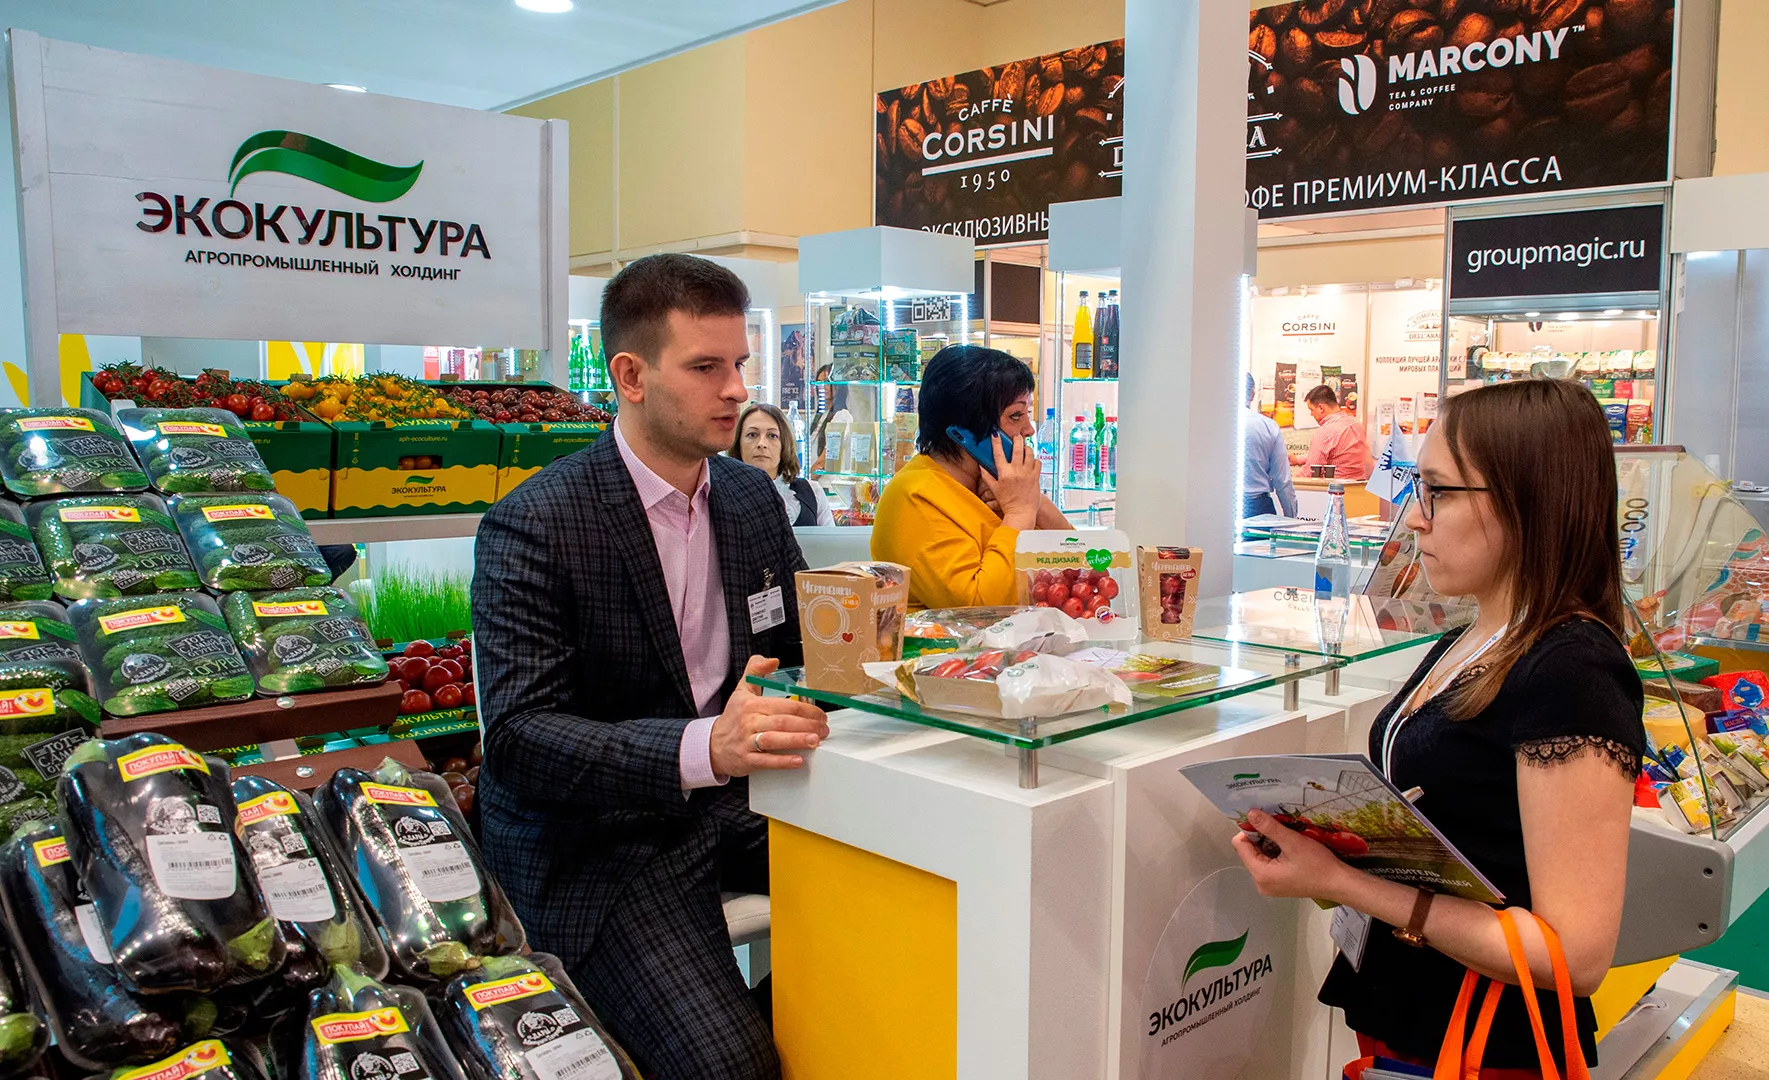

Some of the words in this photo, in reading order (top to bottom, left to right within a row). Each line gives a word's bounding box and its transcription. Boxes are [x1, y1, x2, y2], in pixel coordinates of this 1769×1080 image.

[1388, 27, 1570, 84] MARCONY
[1389, 91, 1407, 100] TEA
[1410, 89, 1416, 97] &
[1420, 83, 1457, 96] COFFEE
[958, 94, 1013, 122] CAFFÈ
[1388, 98, 1434, 111] COMPANY
[921, 115, 1054, 161] CORSINI
[960, 168, 1011, 193] 1950
[1292, 155, 1562, 208] ПРЕМИУМ-КЛАССА
[135, 191, 492, 260] ЭКОКУЛЬТУРА
[185, 249, 380, 276] АГРОПРОМЫШЛЕННЫЙ
[390, 262, 462, 281] ХОЛДИНГ
[1467, 236, 1646, 273] groupmagic.ru
[1282, 322, 1336, 332] CORSINI
[391, 486, 447, 494] ЭКОКУЛЬТУРА
[1036, 557, 1051, 565] РЕД
[129, 752, 181, 771] ПОКУПАЙ!
[1225, 778, 1282, 790] ЭКОКУЛЬТУРА
[476, 983, 519, 1000] ПОКУПАЙ!
[1148, 954, 1273, 1036] ЭКОКУЛЬТУРА
[324, 1021, 371, 1034] ПОКУПАЙ!
[1161, 1002, 1234, 1047] АГРОПРОМЫШЛЕННЫЙ
[1233, 986, 1262, 1010] ХОЛДИНГ
